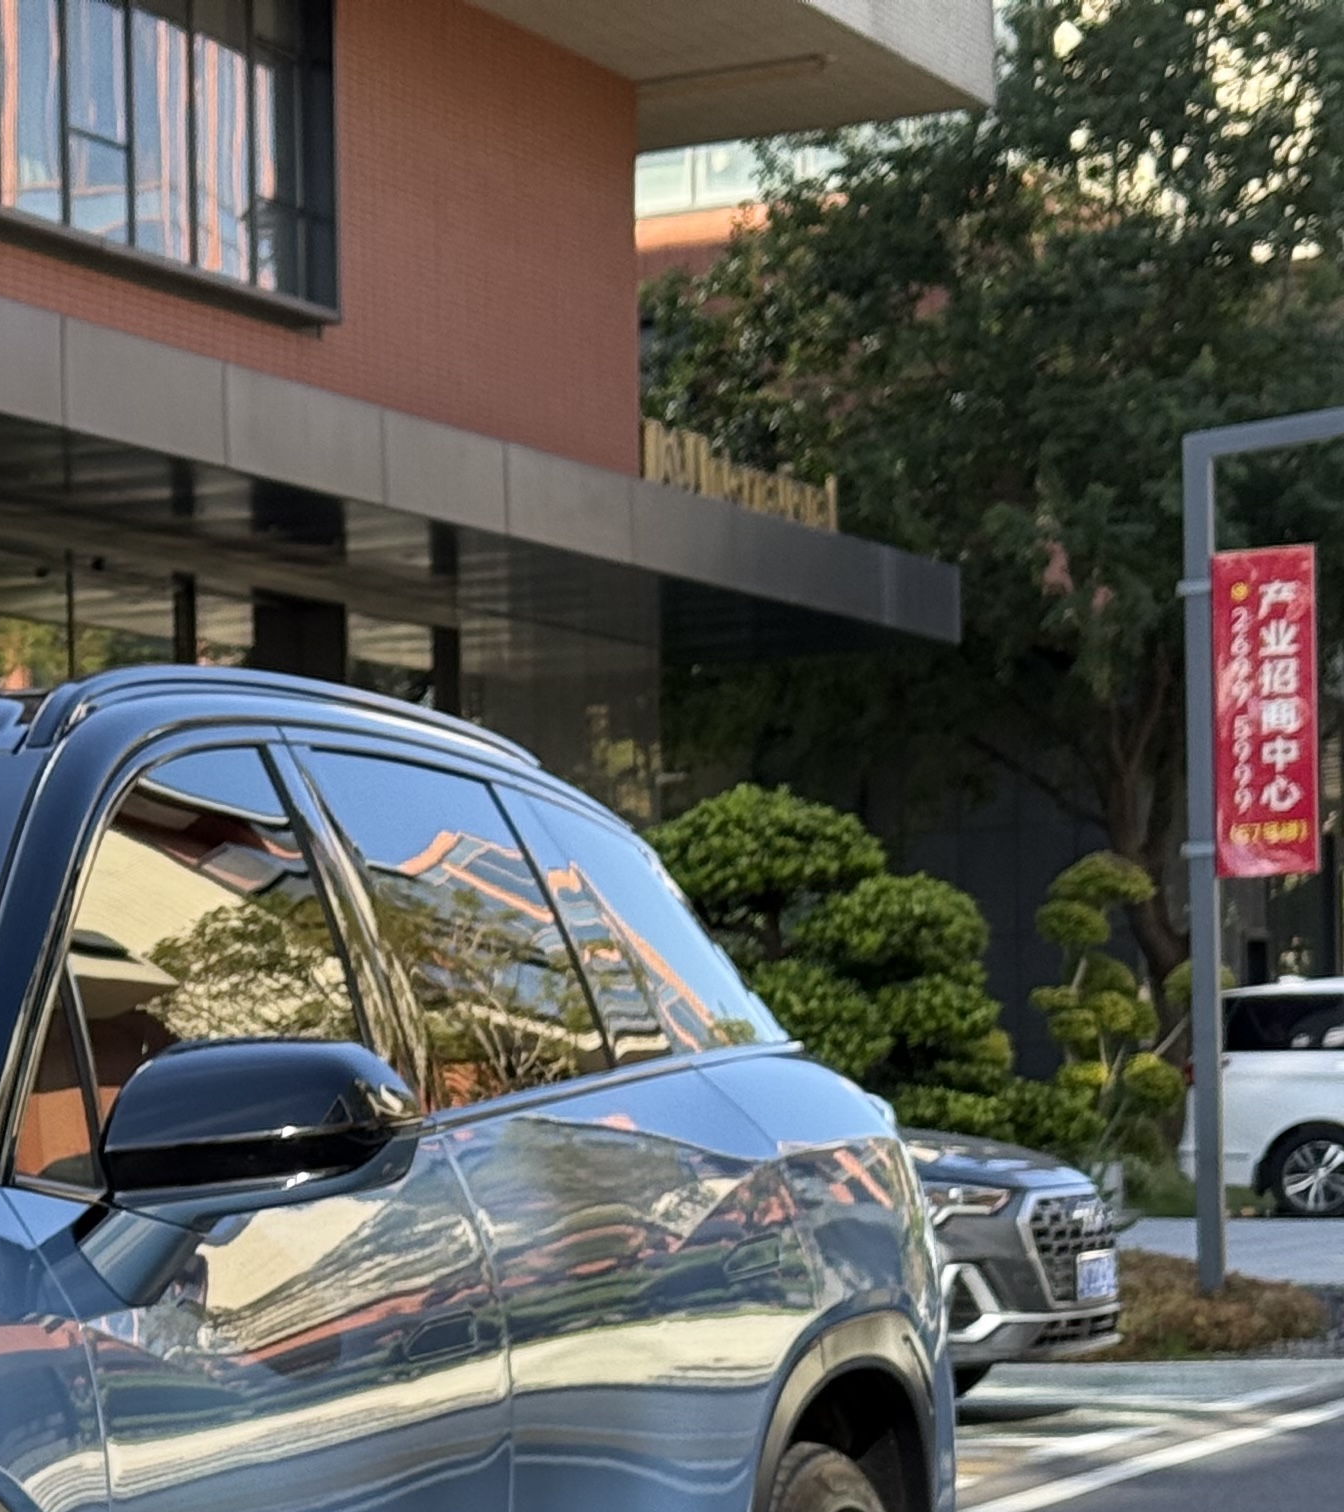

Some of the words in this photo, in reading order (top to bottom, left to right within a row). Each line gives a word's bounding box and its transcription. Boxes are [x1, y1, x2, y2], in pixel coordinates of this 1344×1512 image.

[1258, 579, 1301, 813] 产业招商中心
